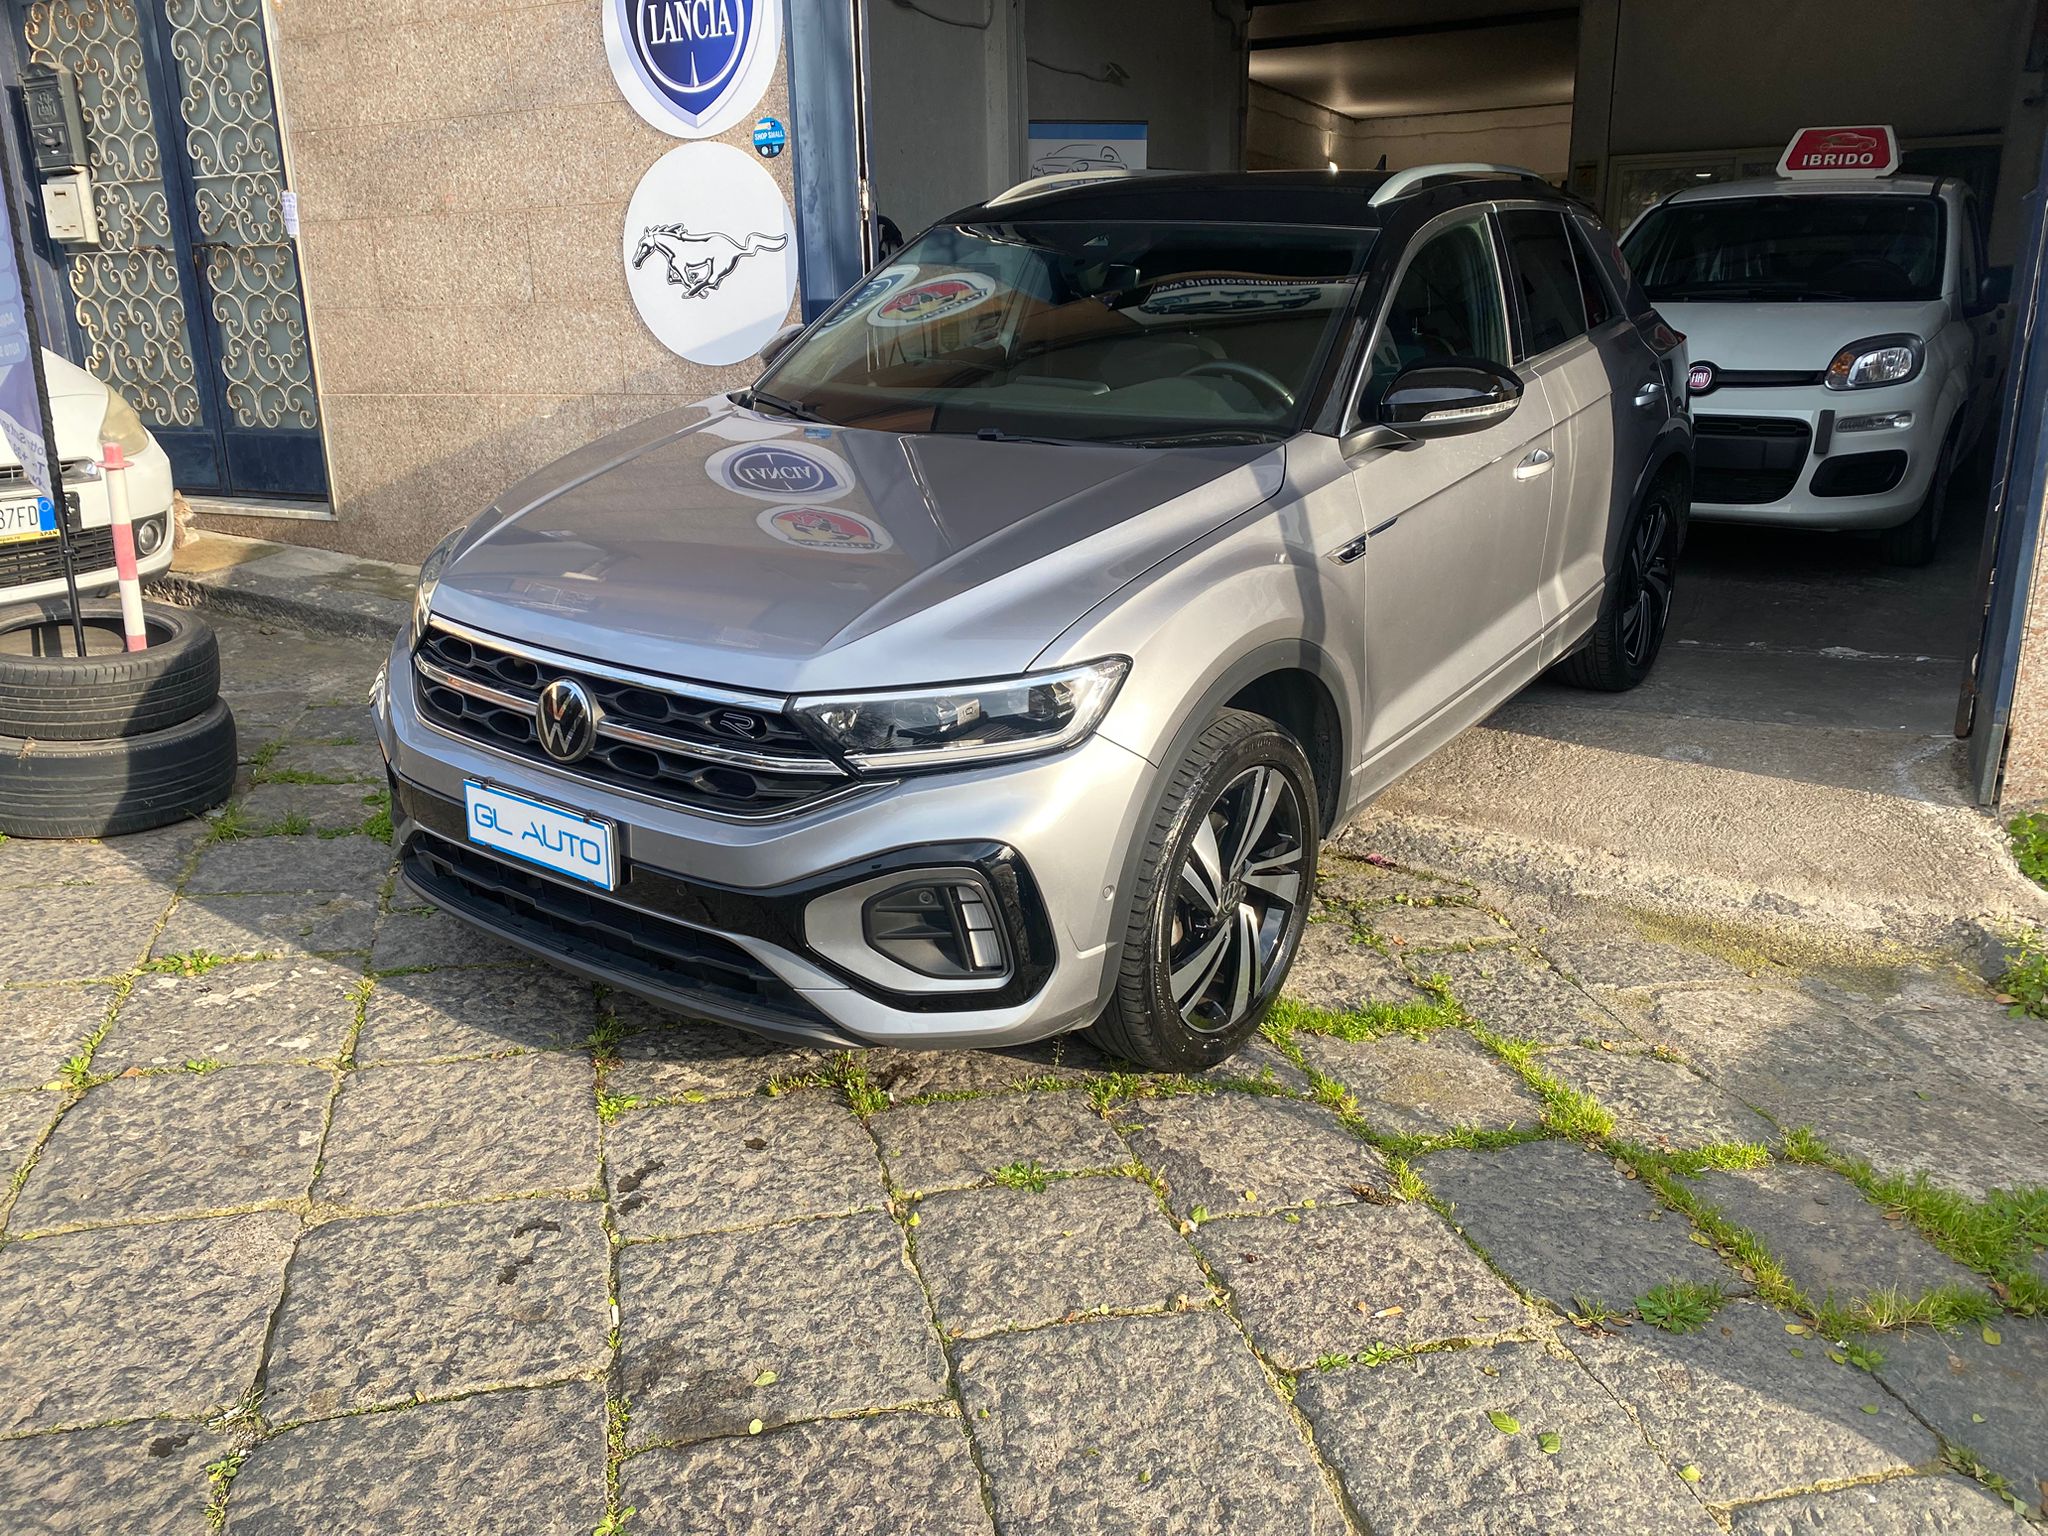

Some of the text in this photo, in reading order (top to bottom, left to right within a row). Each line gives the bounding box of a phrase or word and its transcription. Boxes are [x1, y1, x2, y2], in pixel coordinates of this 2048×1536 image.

[648, 0, 734, 44] LANCIA
[755, 130, 783, 141] SHOP SMALL
[1802, 153, 1873, 166] IBRIDO
[1691, 372, 1708, 383] FIAT
[474, 803, 601, 865] GL AUTO
